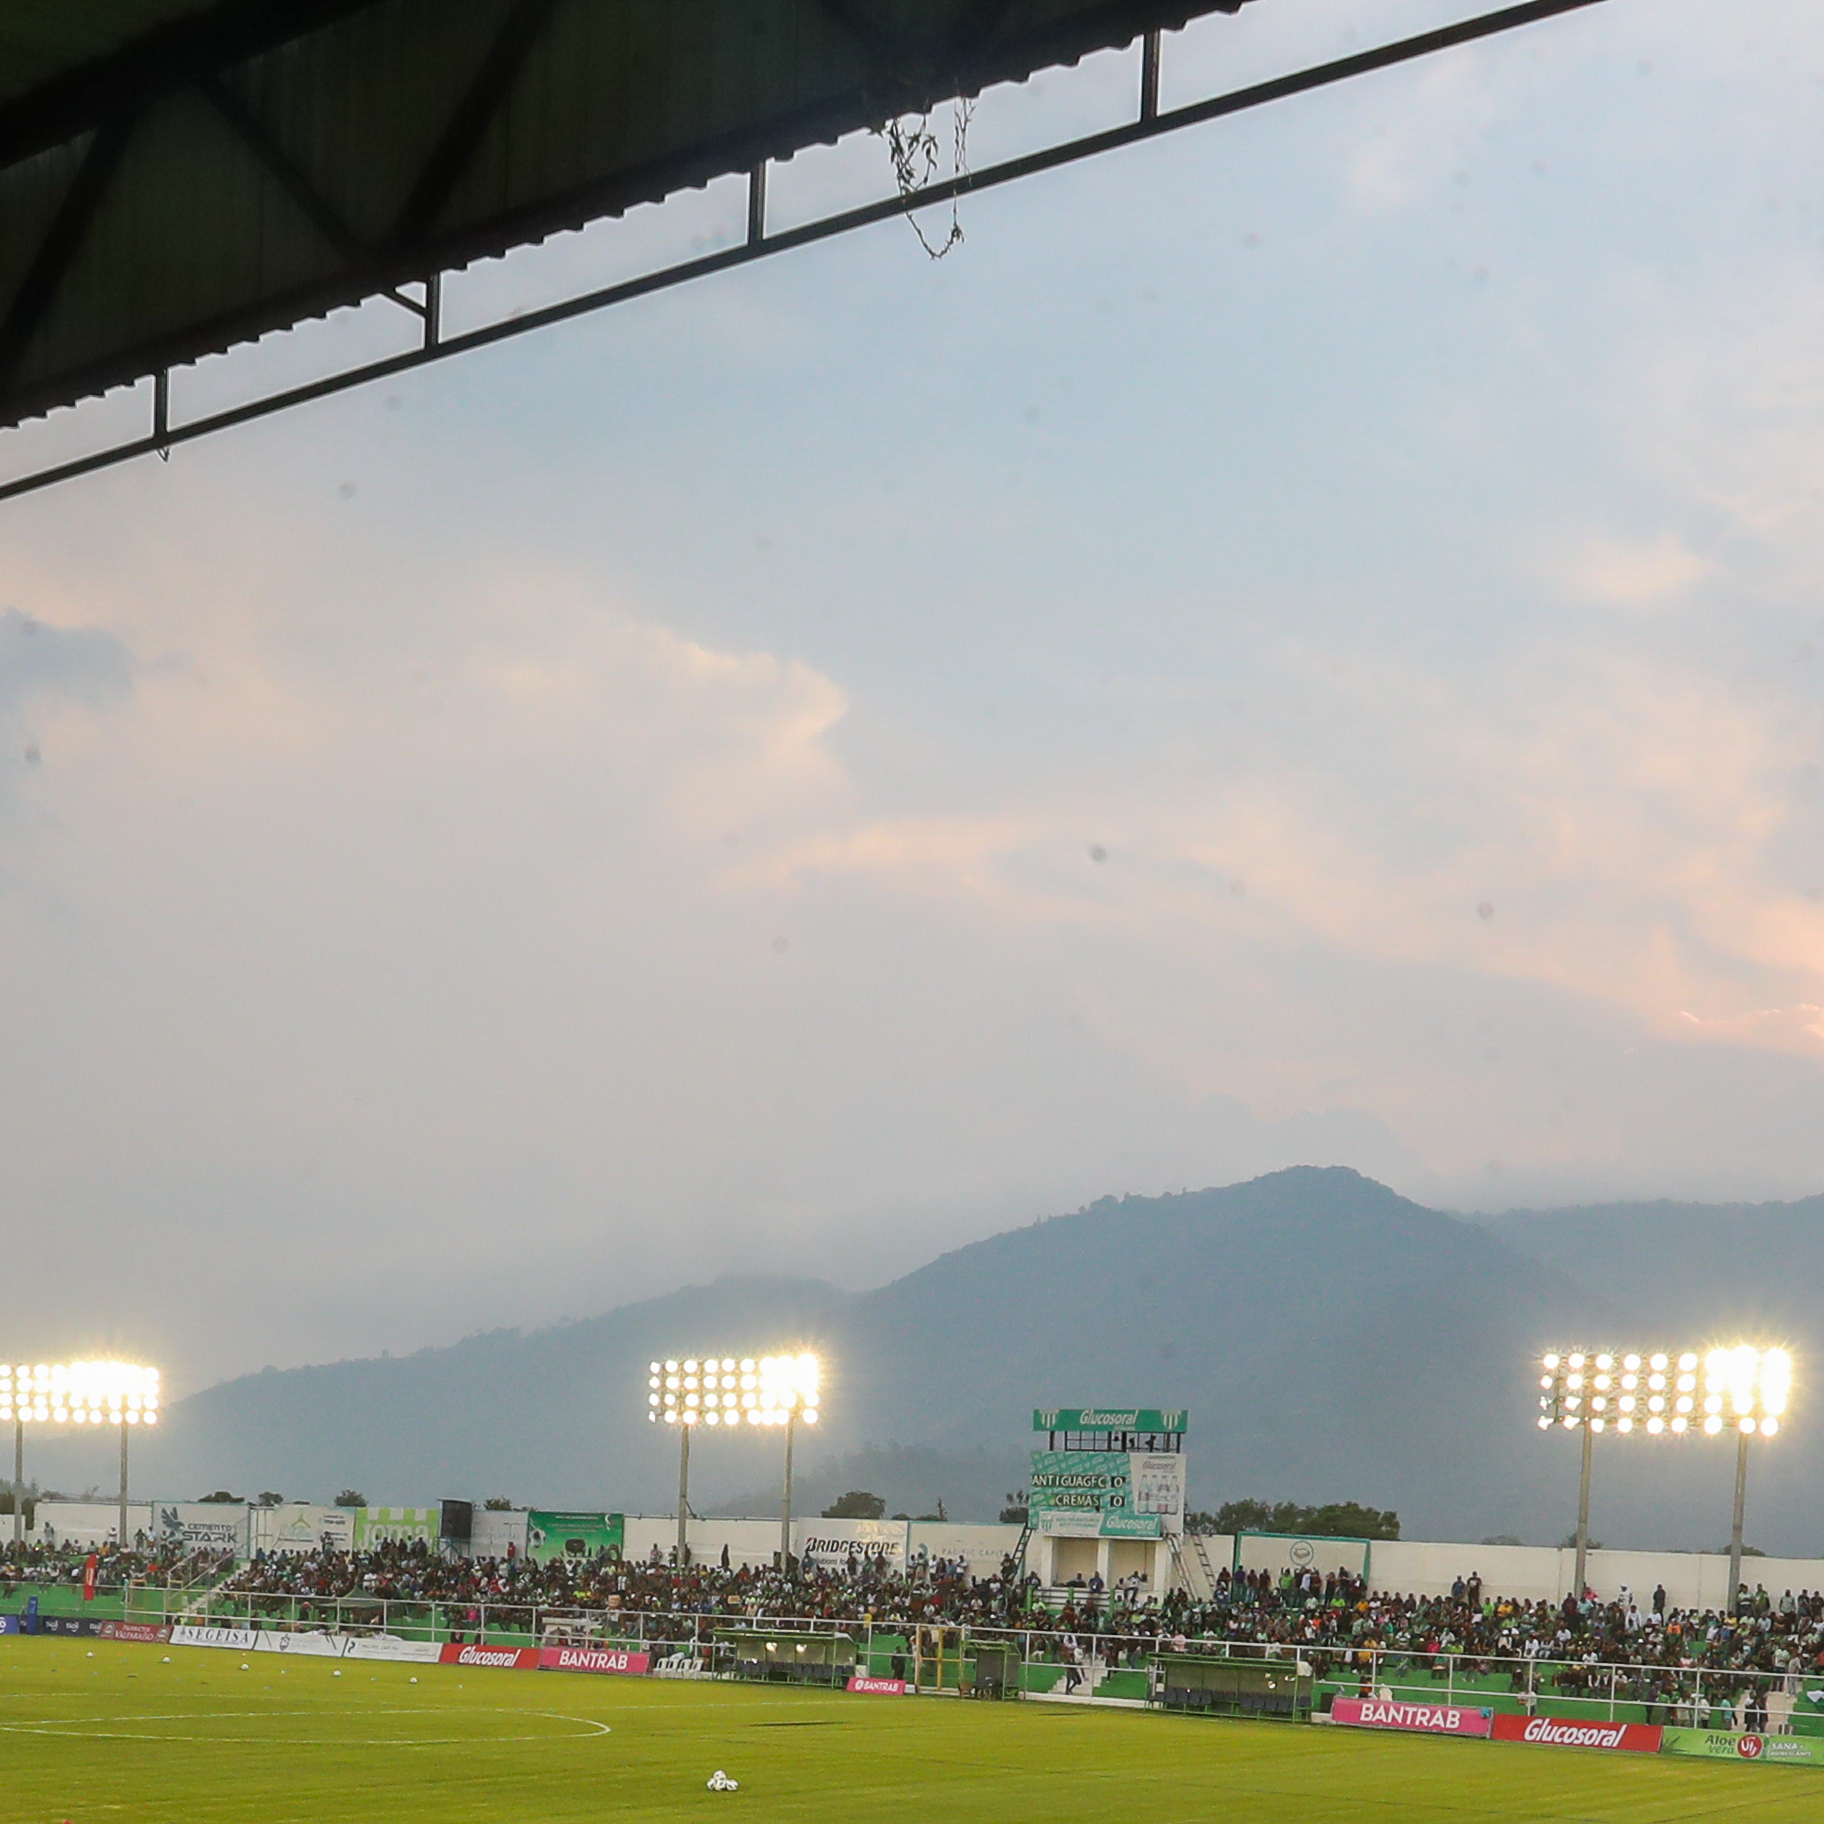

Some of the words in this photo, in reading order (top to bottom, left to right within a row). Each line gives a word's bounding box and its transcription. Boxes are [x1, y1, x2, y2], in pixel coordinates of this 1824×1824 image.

[1080, 1409, 1139, 1426] Glucosoral
[1106, 1514, 1158, 1531] Glucosoral
[181, 1530, 238, 1544] STARK
[805, 1536, 901, 1556] BRIDGESTONE
[186, 1627, 249, 1644] SEGEISA
[459, 1645, 521, 1668] Glucosoral
[559, 1650, 628, 1670] BANTRAB
[865, 1680, 900, 1693] BANTRAB
[1360, 1702, 1461, 1729] BANTRAB
[1524, 1718, 1628, 1748] Glucosoral
[1704, 1734, 1736, 1746] Aloe
